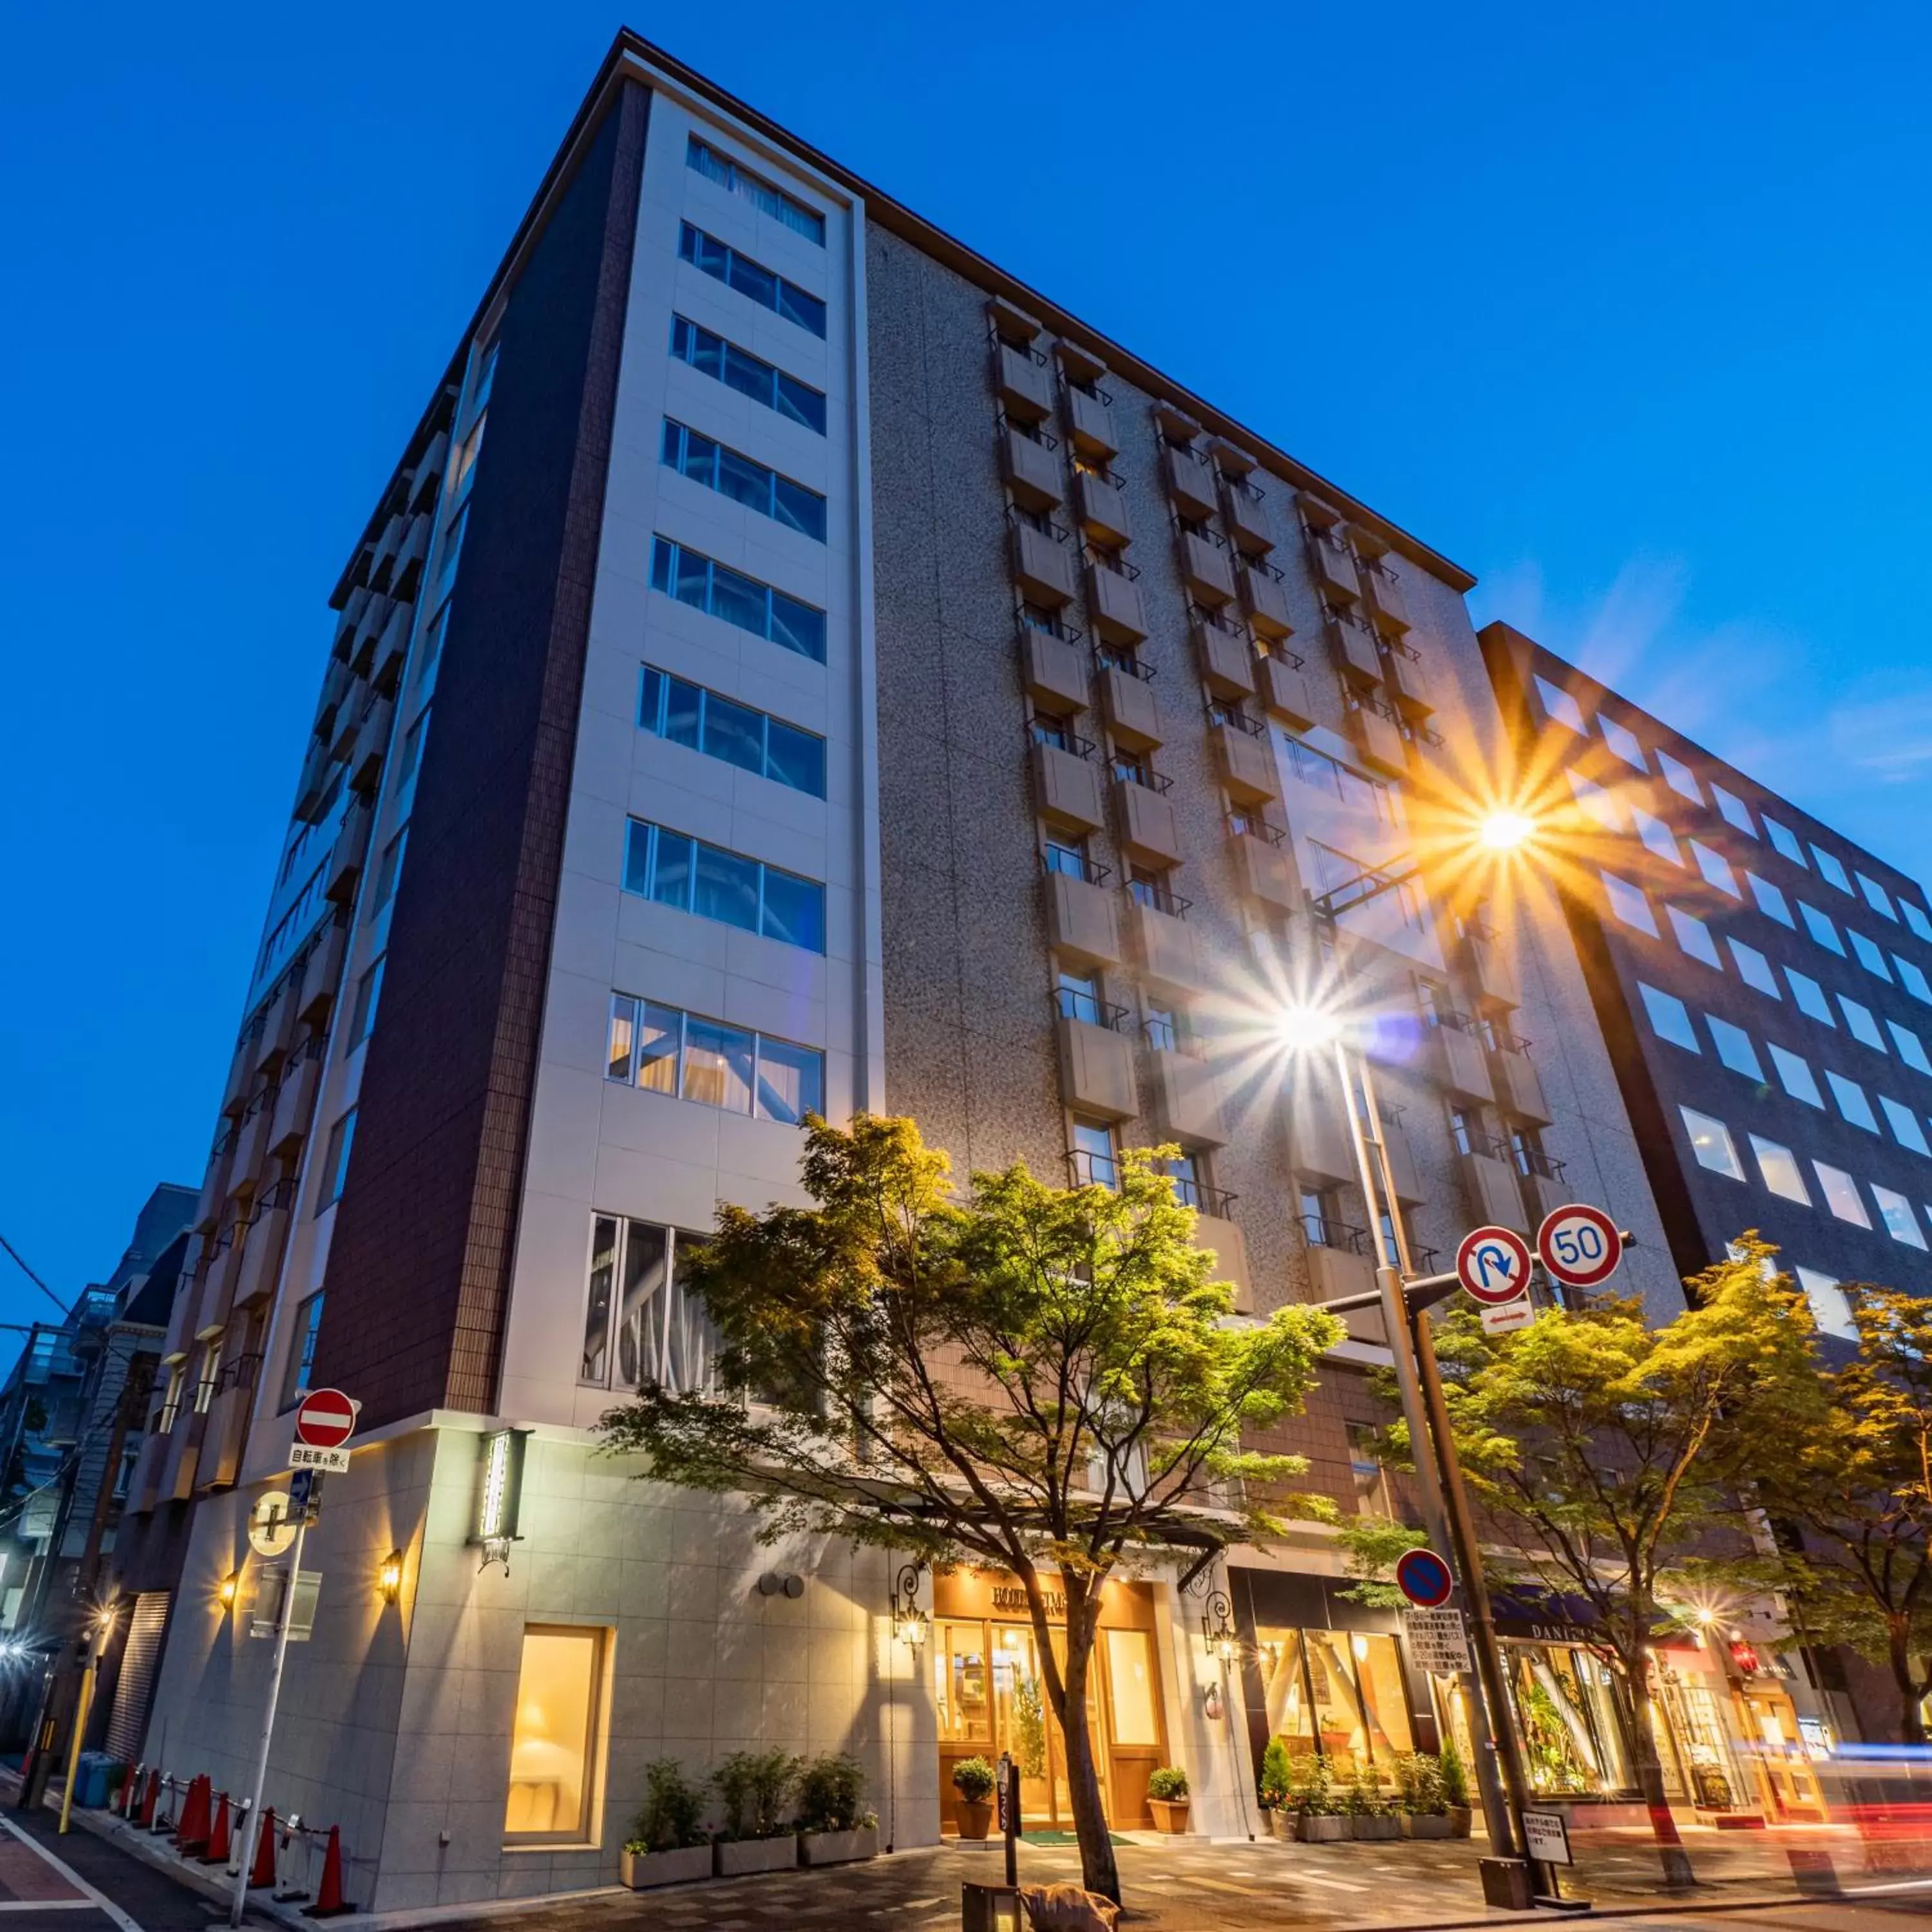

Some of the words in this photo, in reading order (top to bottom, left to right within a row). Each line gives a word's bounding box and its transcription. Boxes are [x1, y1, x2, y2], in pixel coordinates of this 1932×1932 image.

[1555, 1226, 1602, 1264] 50
[292, 1450, 346, 1466] 自転車を除く
